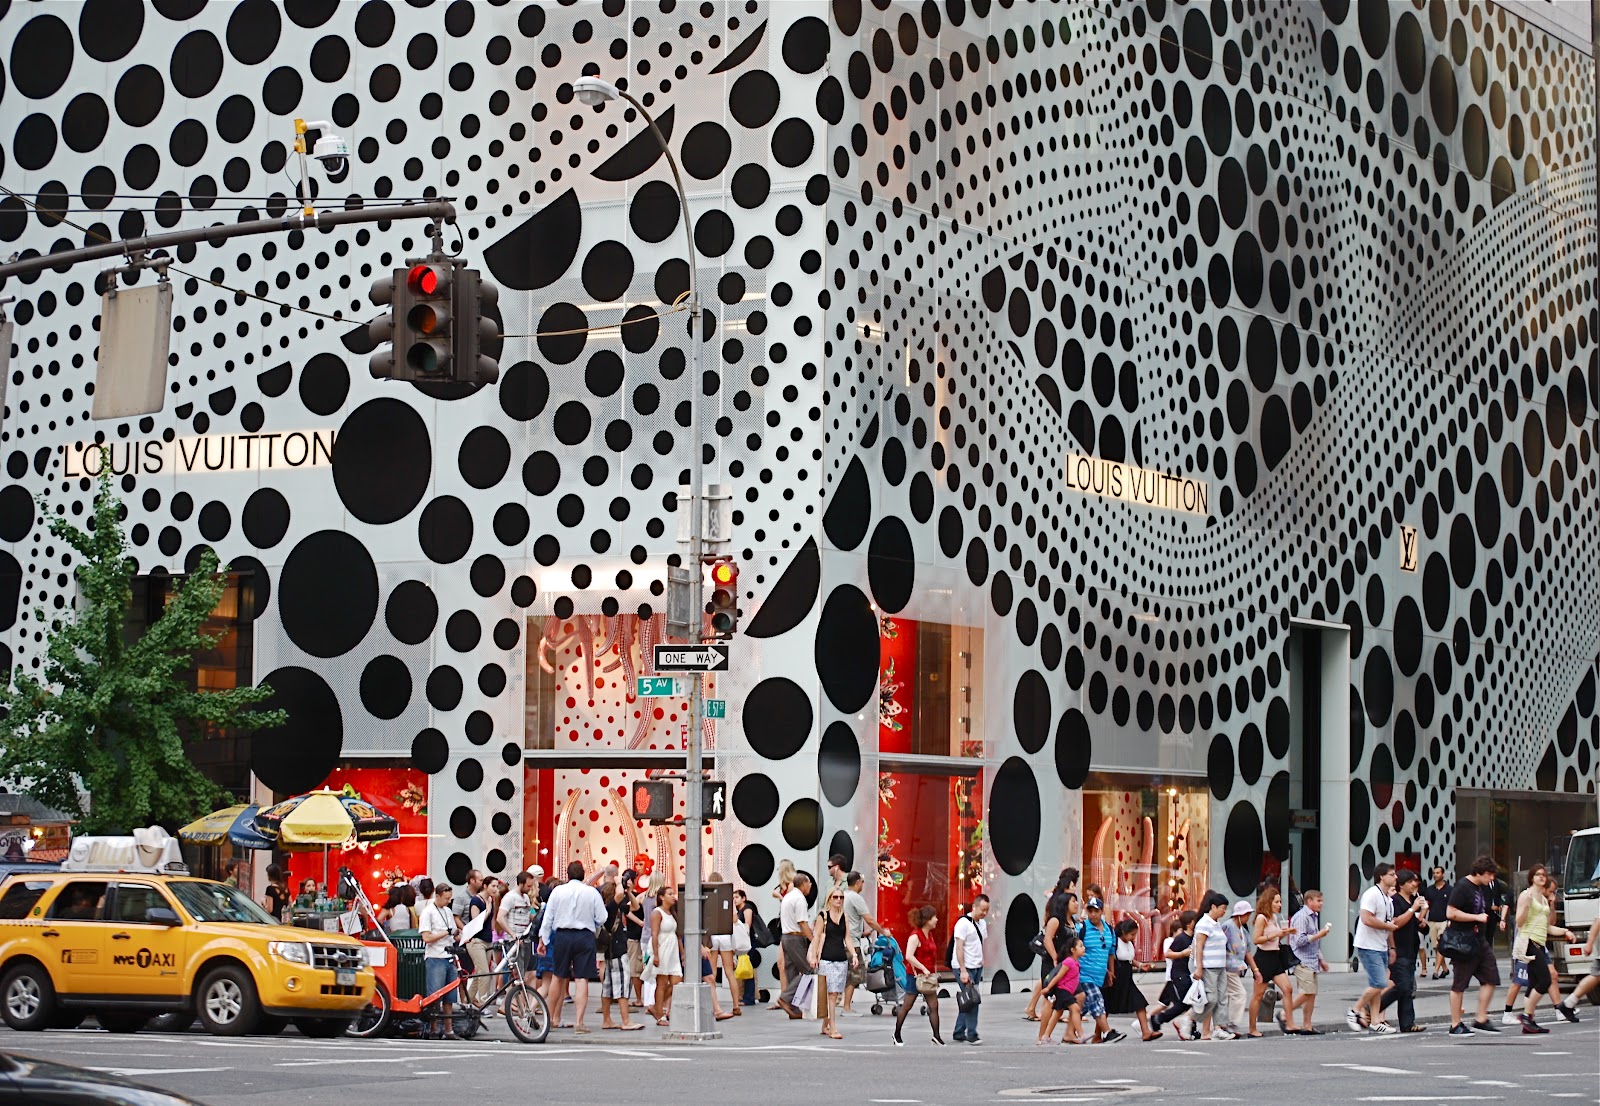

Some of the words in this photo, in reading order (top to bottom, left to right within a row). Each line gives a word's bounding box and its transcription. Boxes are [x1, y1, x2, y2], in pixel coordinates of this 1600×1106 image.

[63, 440, 164, 478] LOUIS
[179, 430, 335, 471] VUITTON
[1066, 454, 1123, 497] LOUIS
[1130, 468, 1208, 514] VUITTON
[665, 653, 686, 664] ONE
[696, 653, 718, 664] WAY
[642, 679, 652, 695] 5
[656, 679, 668, 688] AV
[712, 701, 719, 717] 57
[0, 835, 27, 848] GYROS
[181, 831, 224, 841] SABRETT
[113, 955, 135, 965] NYC
[137, 948, 175, 968] TAXI
